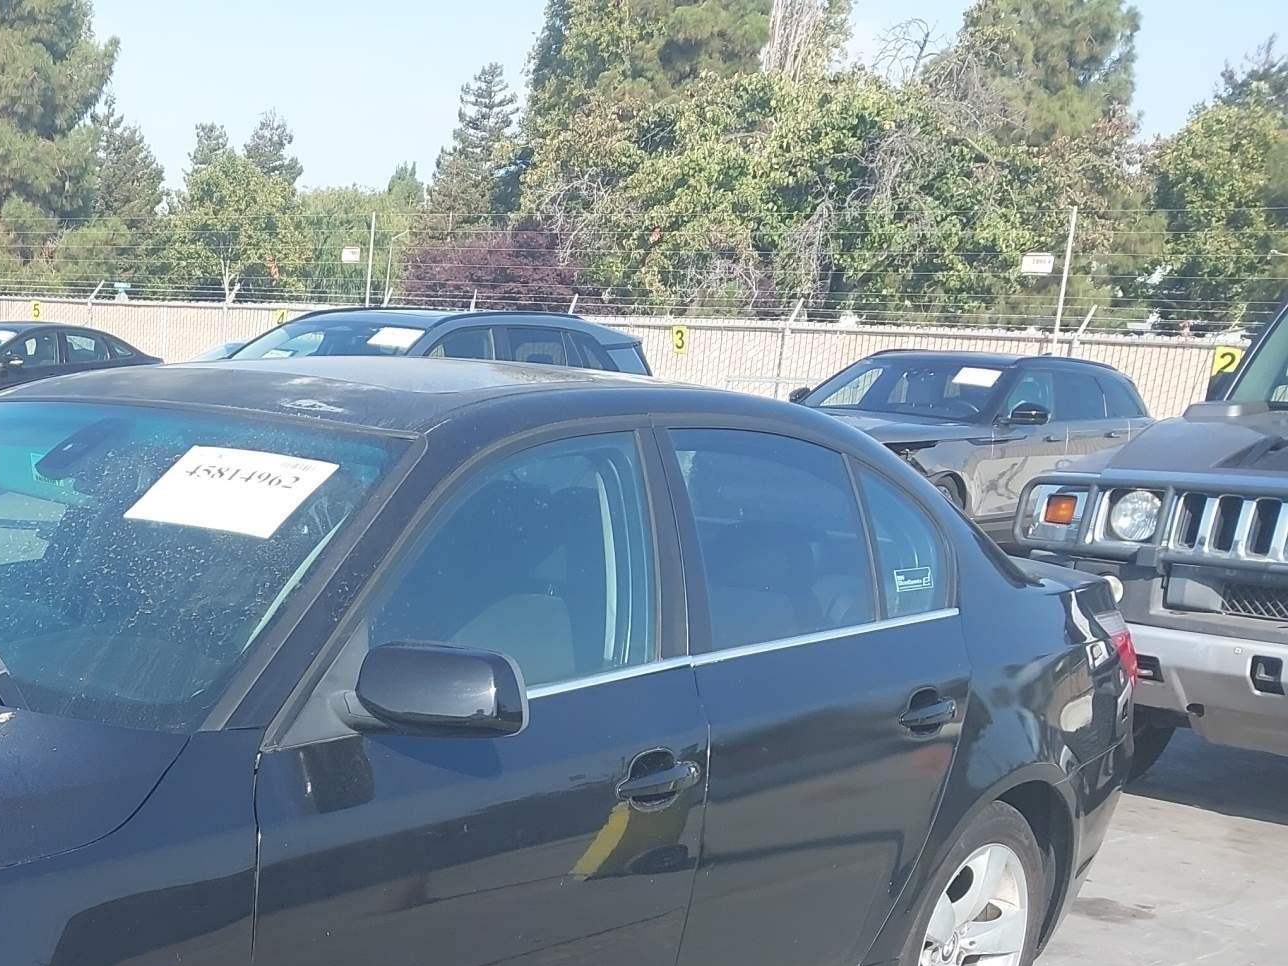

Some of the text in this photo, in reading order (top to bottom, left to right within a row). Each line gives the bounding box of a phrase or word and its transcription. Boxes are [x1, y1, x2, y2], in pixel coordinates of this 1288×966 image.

[32, 303, 40, 318] 5
[675, 329, 685, 349] 3
[1216, 351, 1236, 374] 2
[184, 463, 301, 489] 45814962
